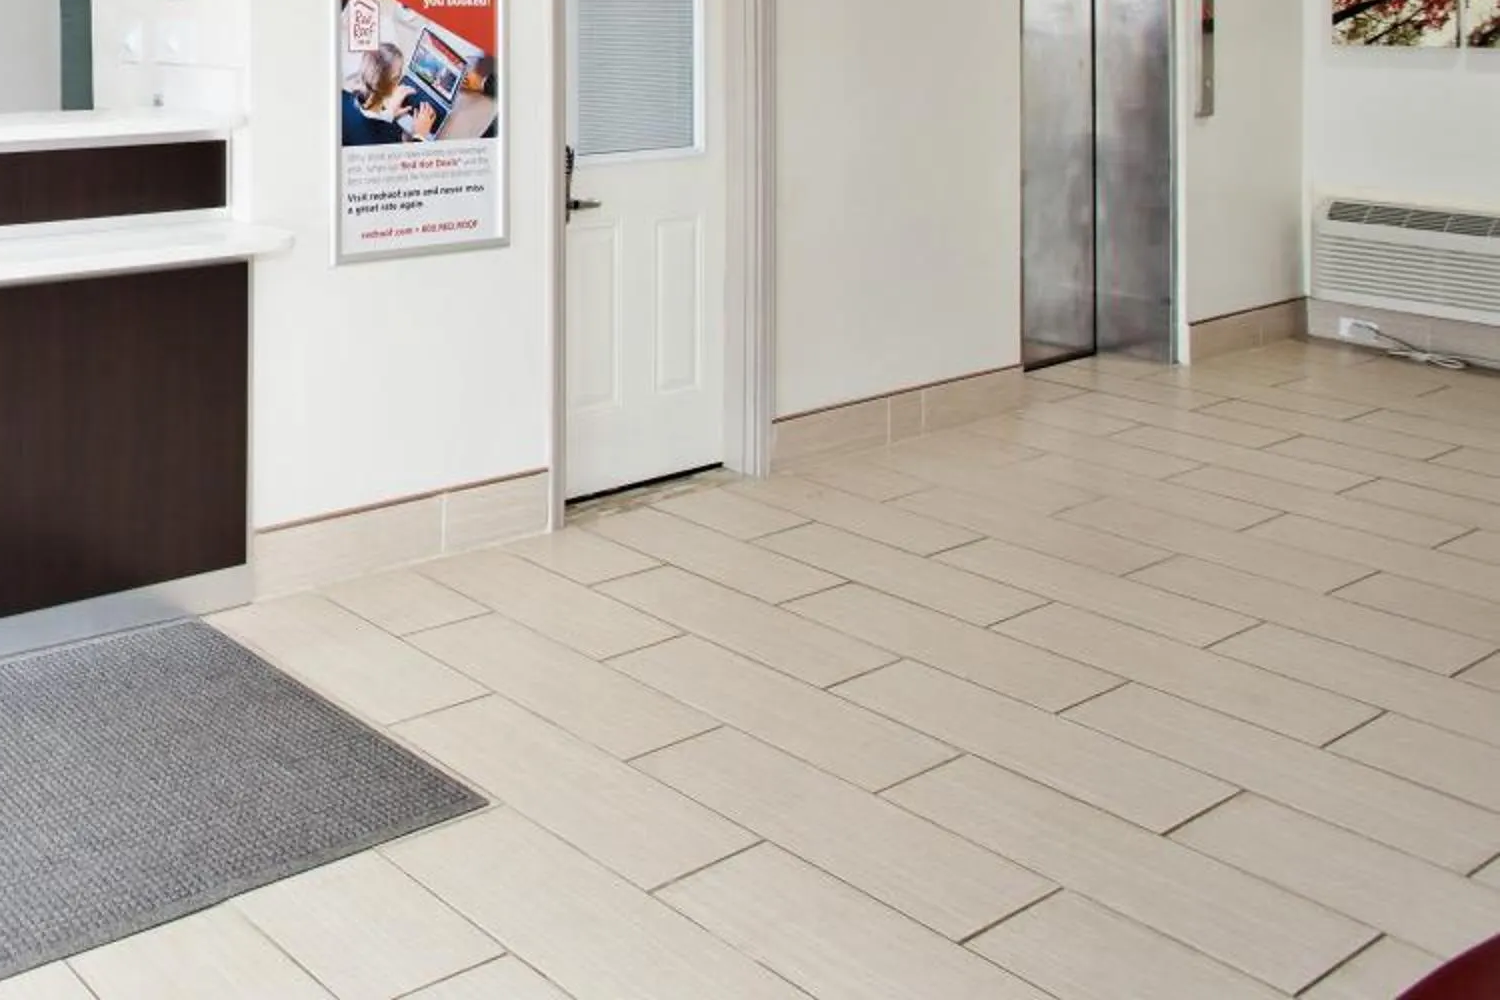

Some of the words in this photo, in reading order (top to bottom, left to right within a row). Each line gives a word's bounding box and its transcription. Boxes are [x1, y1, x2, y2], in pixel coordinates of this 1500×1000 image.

[347, 192, 368, 203] Visit
[423, 186, 439, 197] and
[440, 186, 463, 195] never
[465, 184, 485, 193] miss
